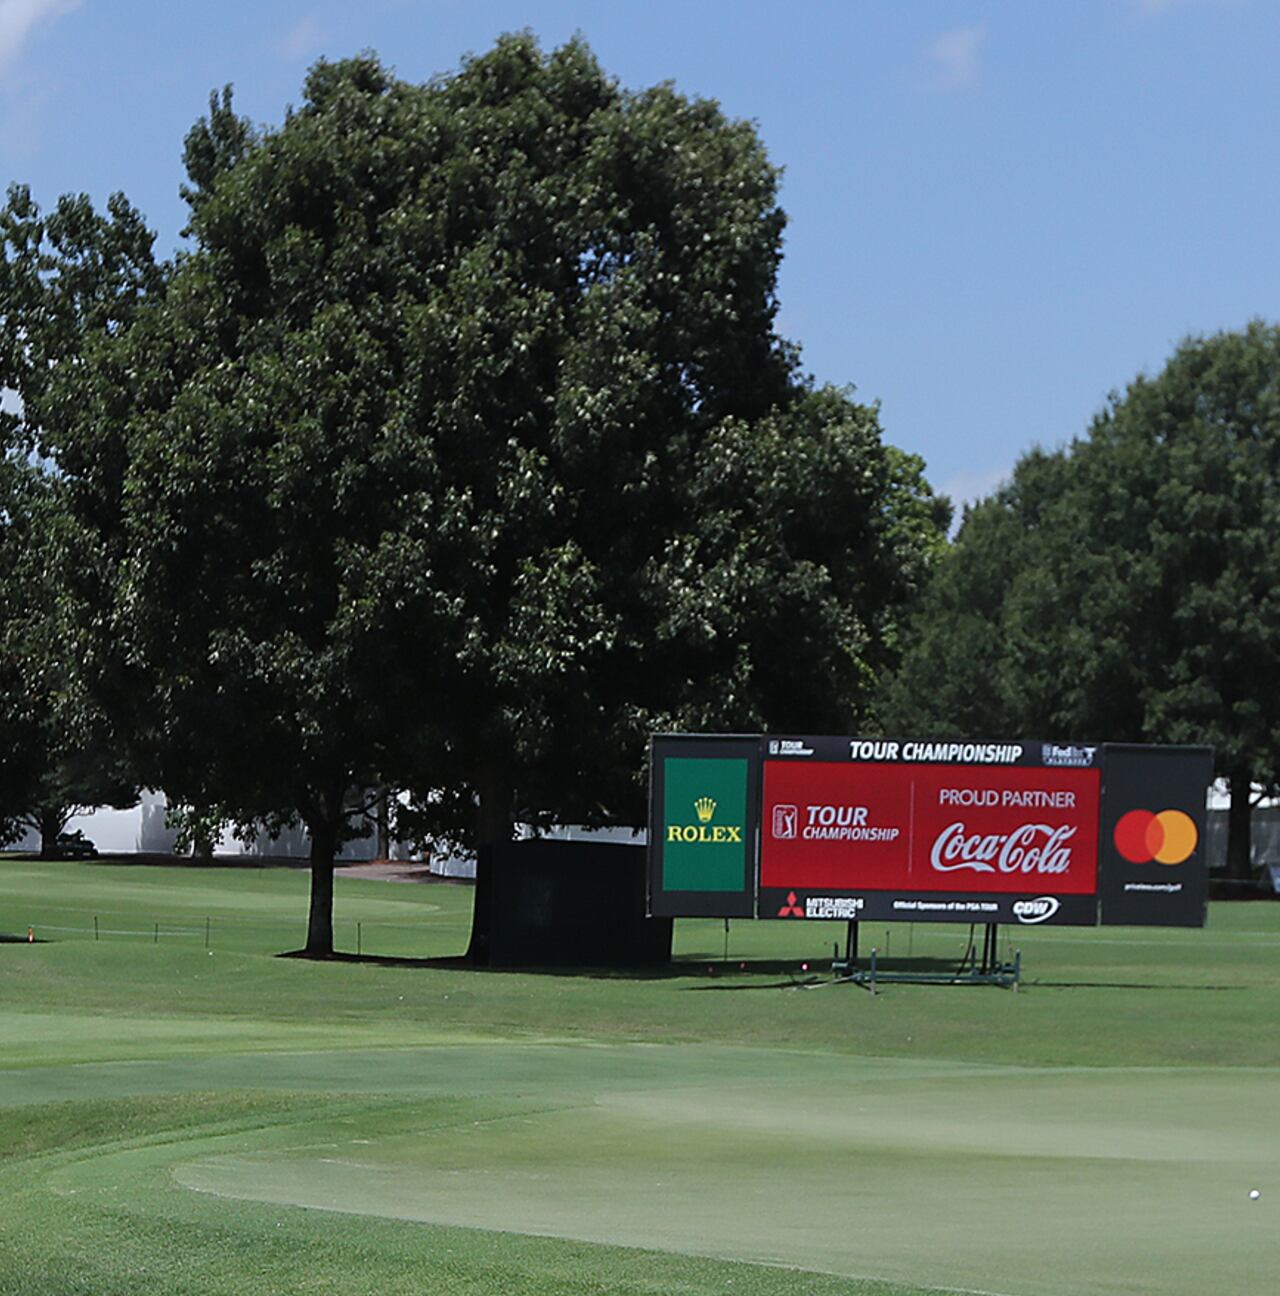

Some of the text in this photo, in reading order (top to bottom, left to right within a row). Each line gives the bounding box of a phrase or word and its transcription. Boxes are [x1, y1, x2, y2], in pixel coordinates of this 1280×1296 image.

[850, 741, 898, 760] TOUR
[902, 743, 1023, 763] CHAMPIONSHIP
[939, 789, 1076, 808] PROUD PARTNER
[806, 806, 868, 826] TOUR
[667, 825, 742, 843] ROLEX
[803, 826, 899, 840] CHAMPIONSHIP
[930, 822, 1077, 873] Coca-Cola
[806, 898, 864, 909] MITSUBISHI
[806, 907, 856, 918] ELECTRIC
